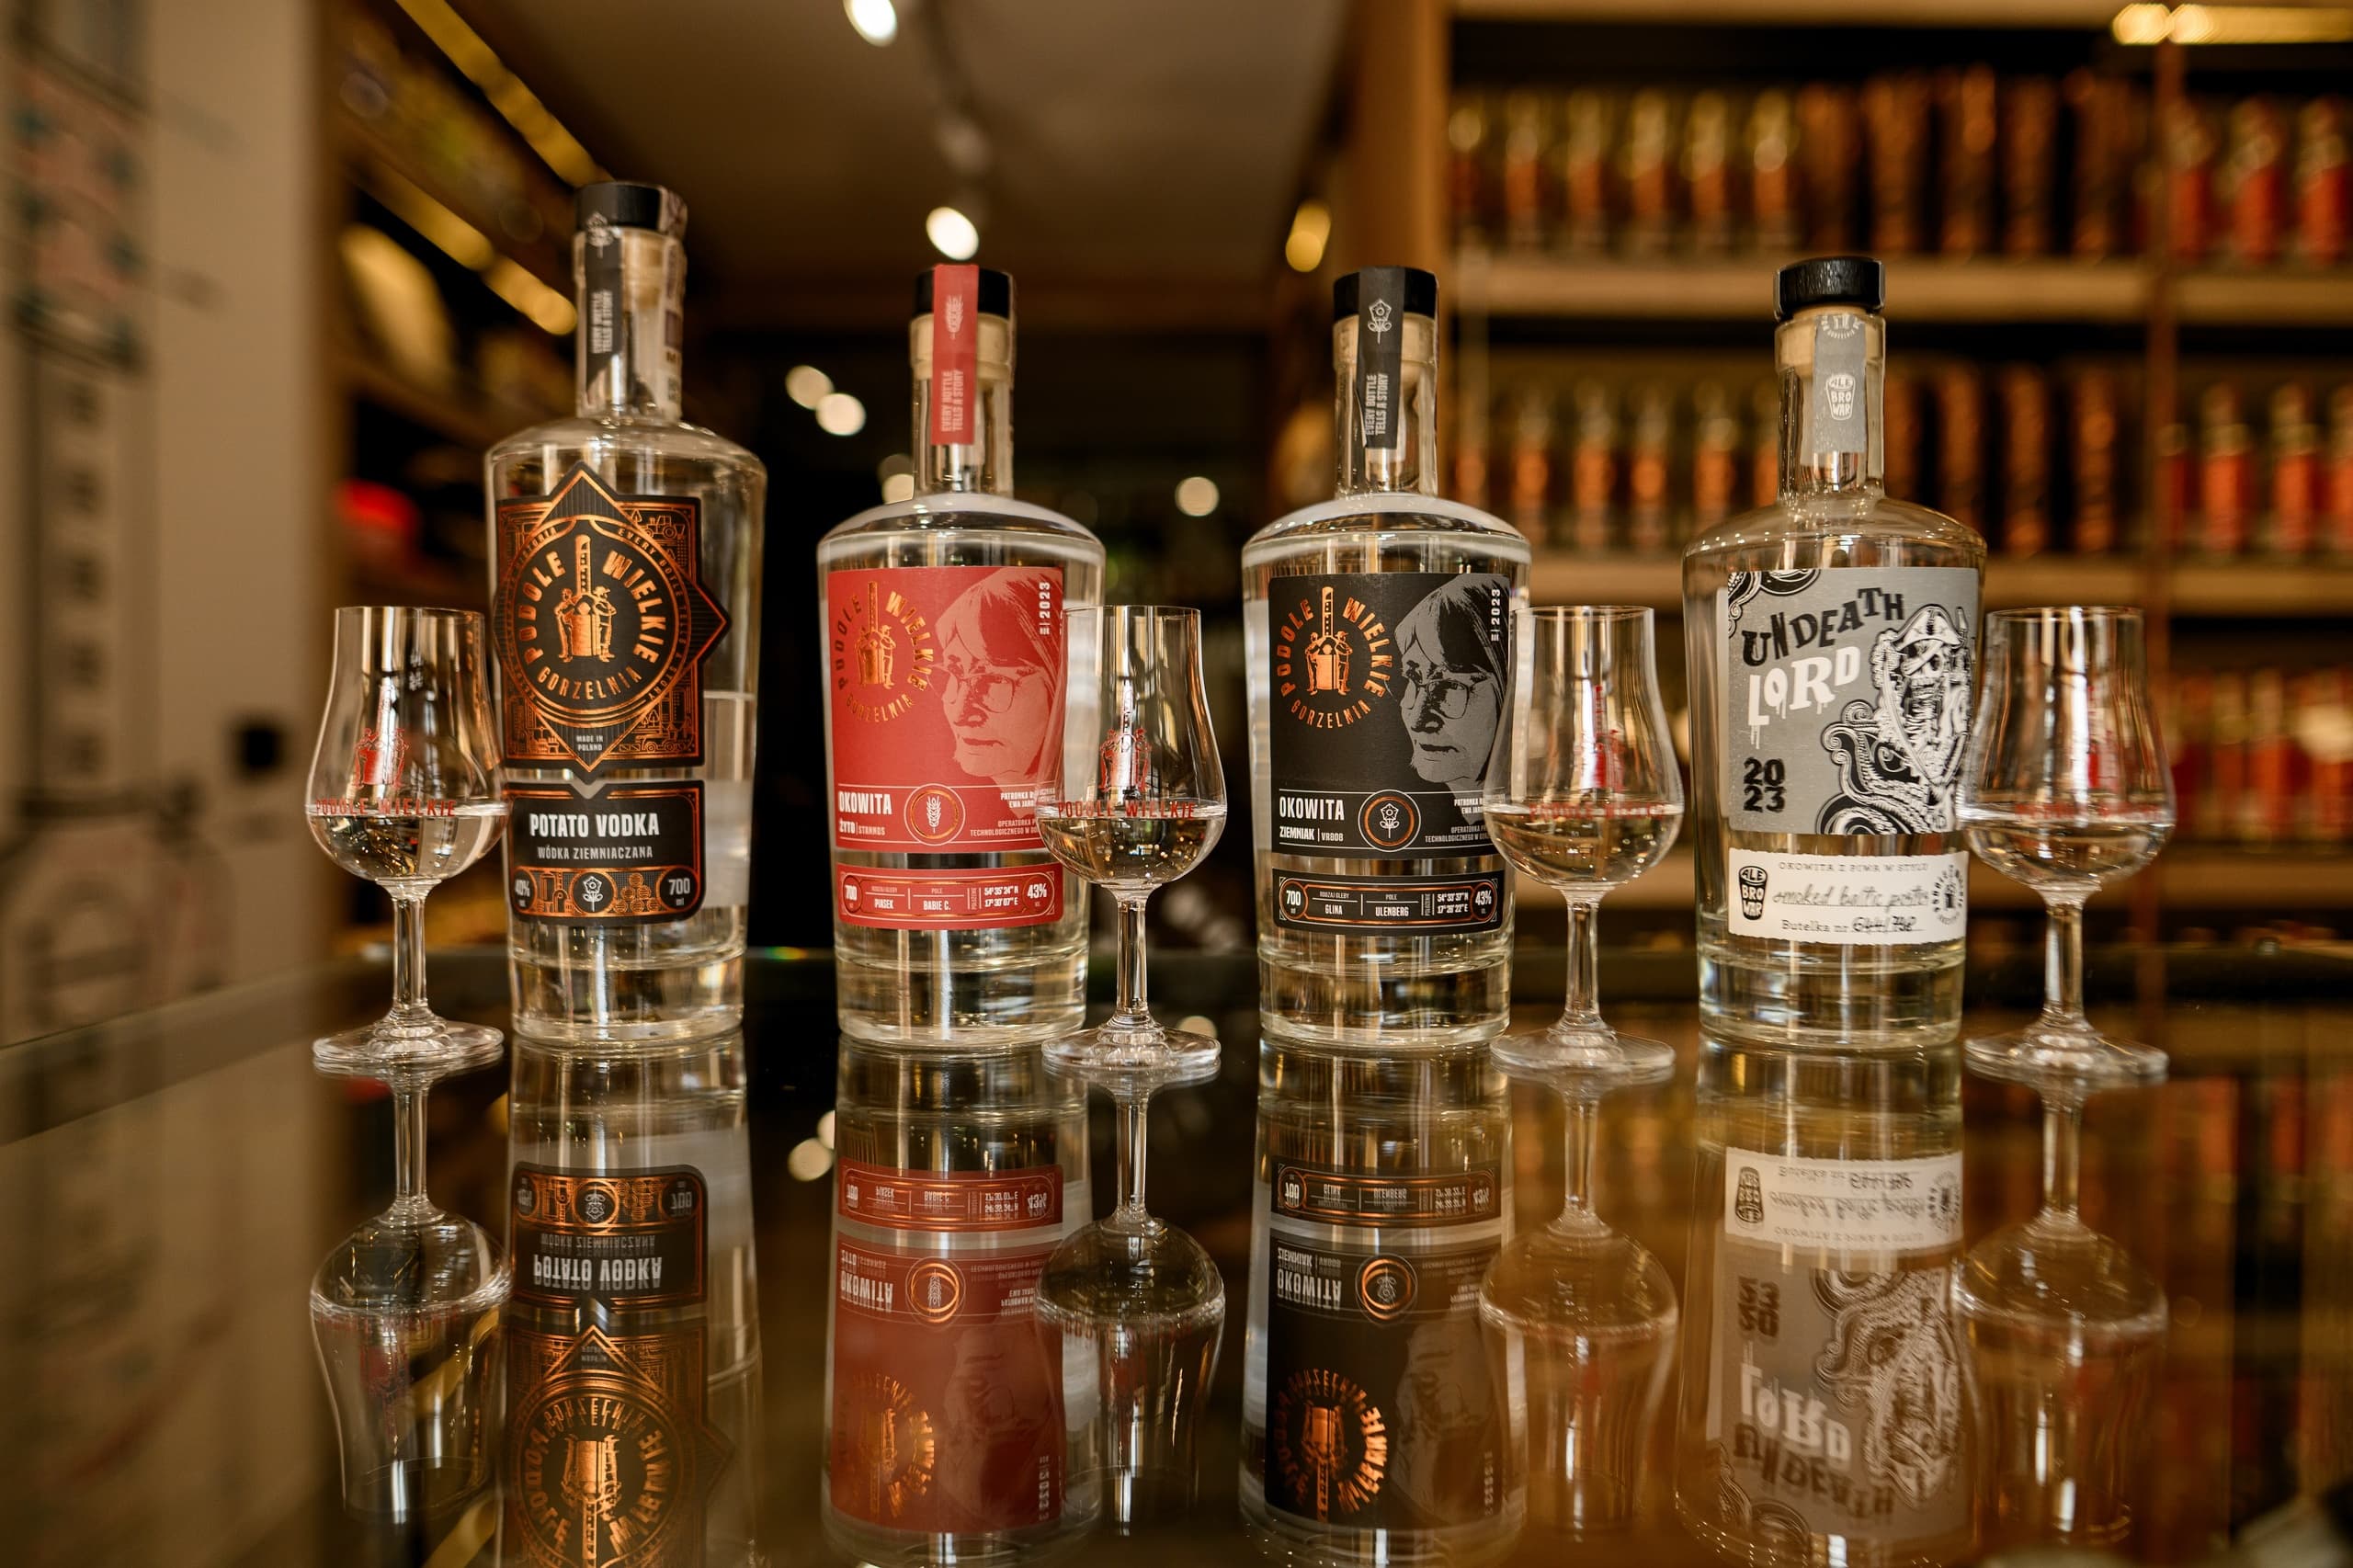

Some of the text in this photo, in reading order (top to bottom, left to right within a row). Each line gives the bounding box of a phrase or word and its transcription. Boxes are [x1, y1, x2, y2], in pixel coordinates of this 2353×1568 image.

[1377, 373, 1389, 400] STORY
[1830, 391, 1852, 403] BRO
[1365, 374, 1377, 436] EVERY BOTTLE
[1831, 403, 1851, 415] WAR
[1376, 409, 1386, 436] TELLS
[617, 527, 657, 555] EVERY
[517, 551, 567, 665] PODOLE
[602, 550, 667, 664] WIELKIE
[1039, 581, 1051, 619] 2023
[1490, 588, 1501, 625] 2023
[1741, 586, 1905, 667] UNDEATH
[885, 591, 935, 692] WIELKIE
[1276, 597, 1393, 698] PODOLE WIELKIE
[537, 665, 642, 700] GORZELNIA
[1747, 646, 1861, 741] LORD
[1290, 699, 1371, 729] GORZELNIA
[1743, 756, 1786, 787] 20
[315, 798, 457, 817] PODOLE WIELKIE
[837, 790, 892, 815] OKOWITA
[1058, 801, 1115, 819] PODOLE
[1124, 801, 1195, 820] WIELKIE
[1279, 796, 1345, 821] OKOWITA
[1743, 786, 1786, 813] 23
[529, 812, 660, 838] POTATO VODKA
[1279, 825, 1315, 841] ZIEMNIAK
[537, 844, 654, 860] WÓDKA ZIEMNIACZANA
[1741, 869, 1764, 881] ALE
[1778, 860, 1835, 872] OKOWITA
[668, 878, 690, 896] 700
[1027, 882, 1047, 899] 43%
[1286, 889, 1302, 906] 700
[1474, 889, 1492, 906] 43%
[1741, 884, 1765, 901] BRO
[923, 900, 943, 911] BABIE
[1324, 904, 1343, 915] GLINA
[1375, 905, 1409, 917] ULENBERG
[1780, 918, 1831, 933] Butelka
